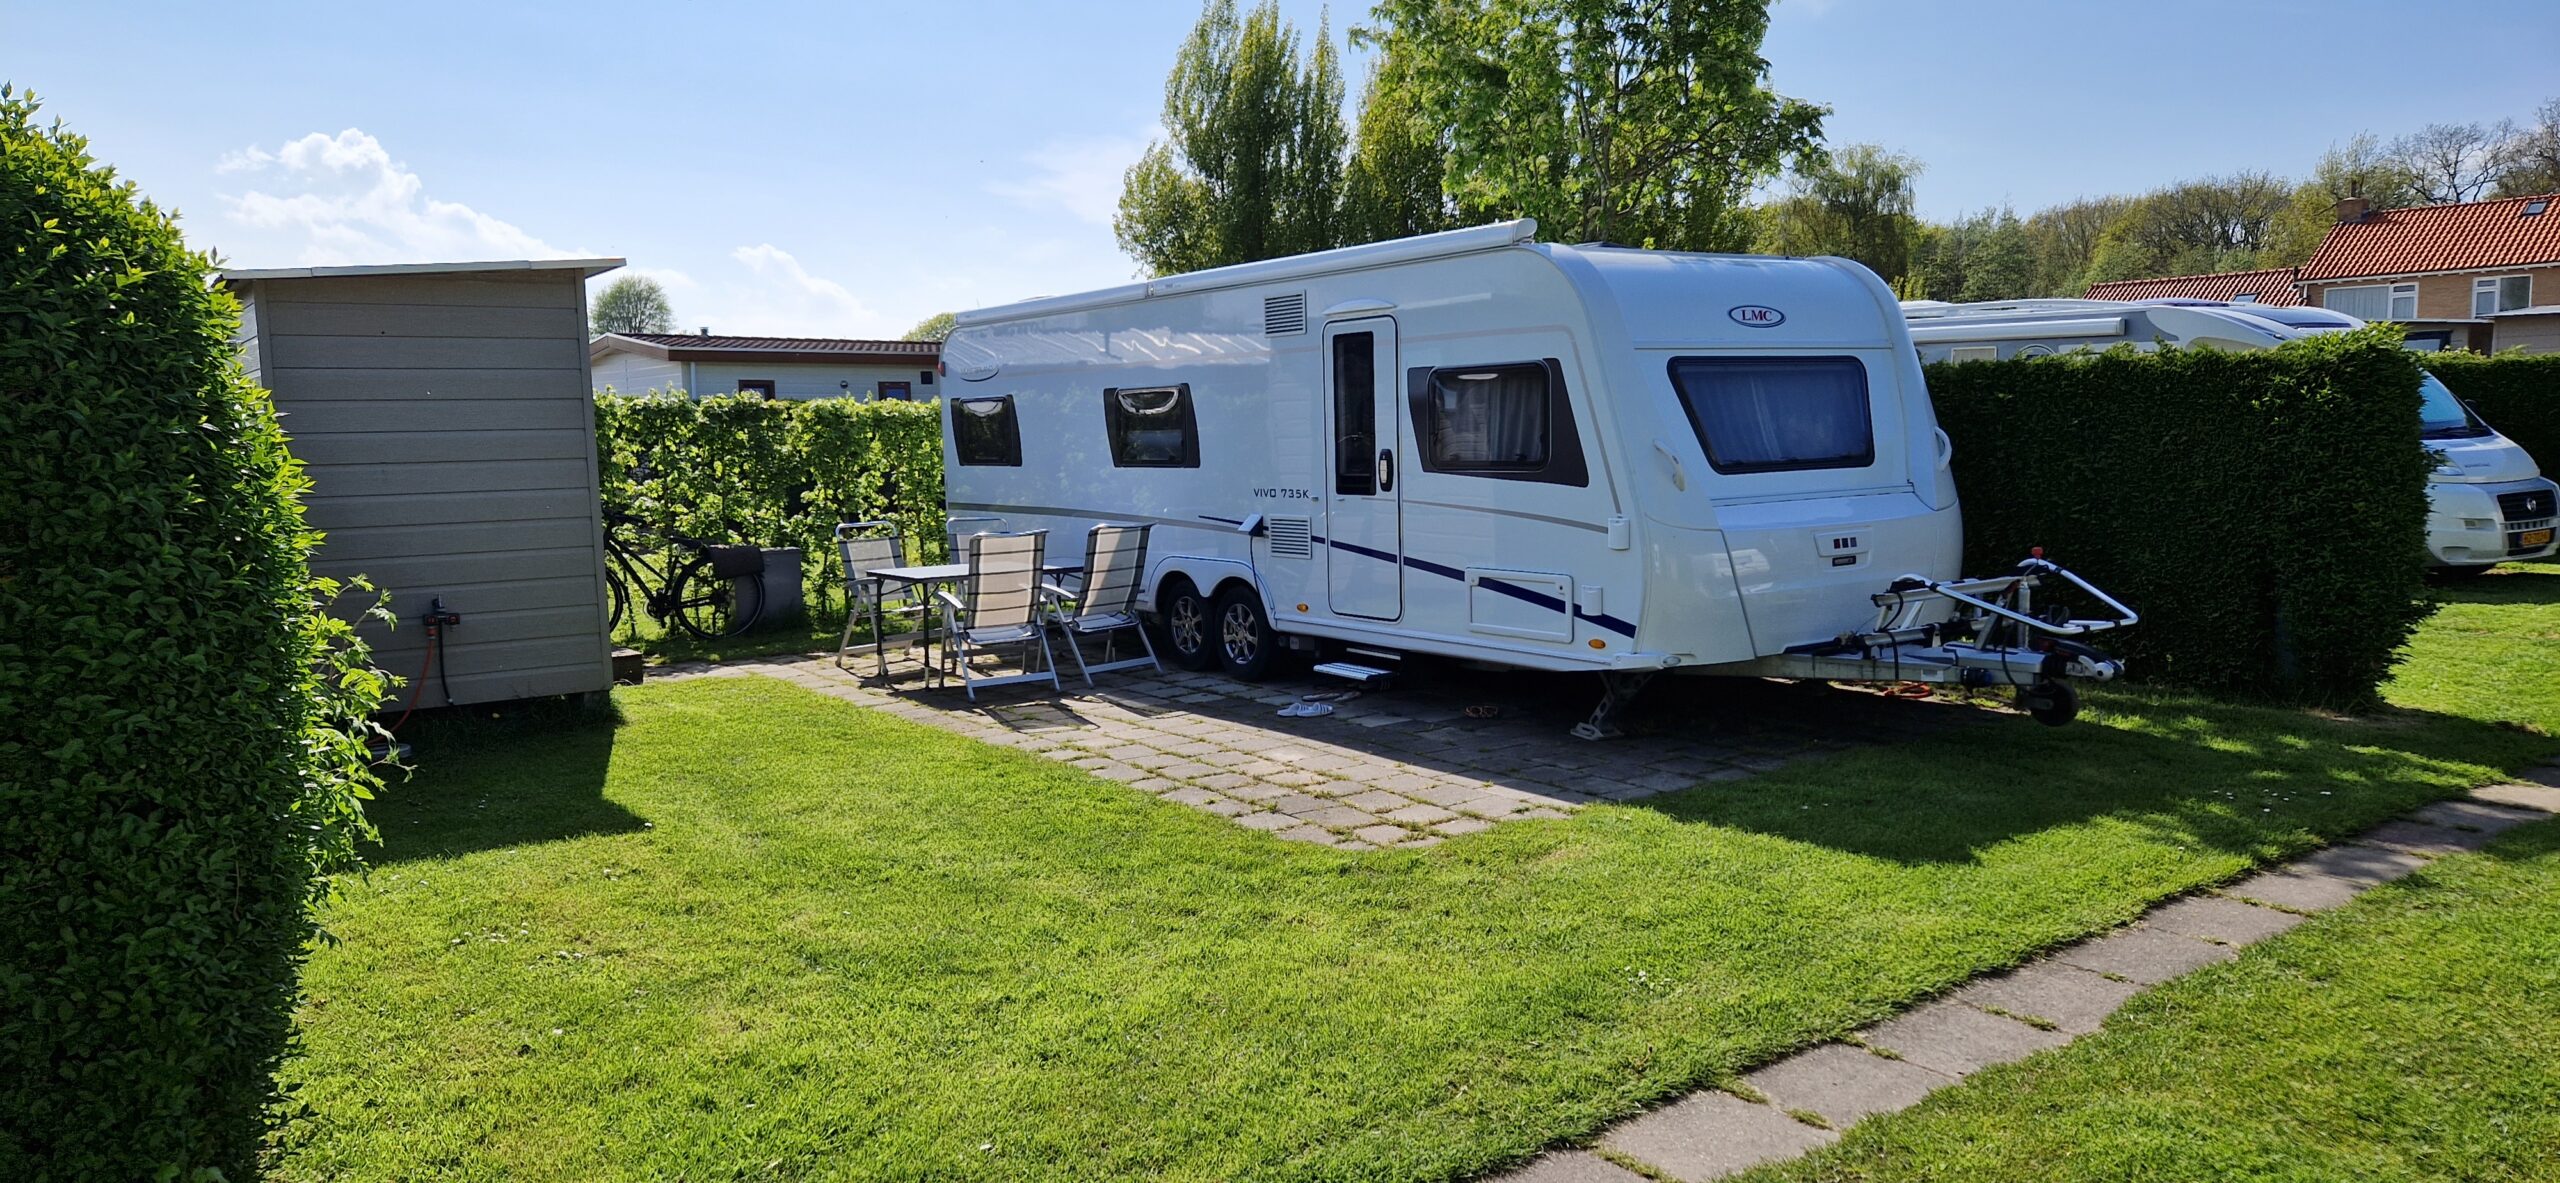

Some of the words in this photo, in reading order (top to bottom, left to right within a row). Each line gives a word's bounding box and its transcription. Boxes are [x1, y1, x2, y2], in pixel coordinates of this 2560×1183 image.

[1742, 310, 1773, 321] LMC
[1253, 488, 1277, 498] VIVO
[1281, 489, 1310, 499] 735K
